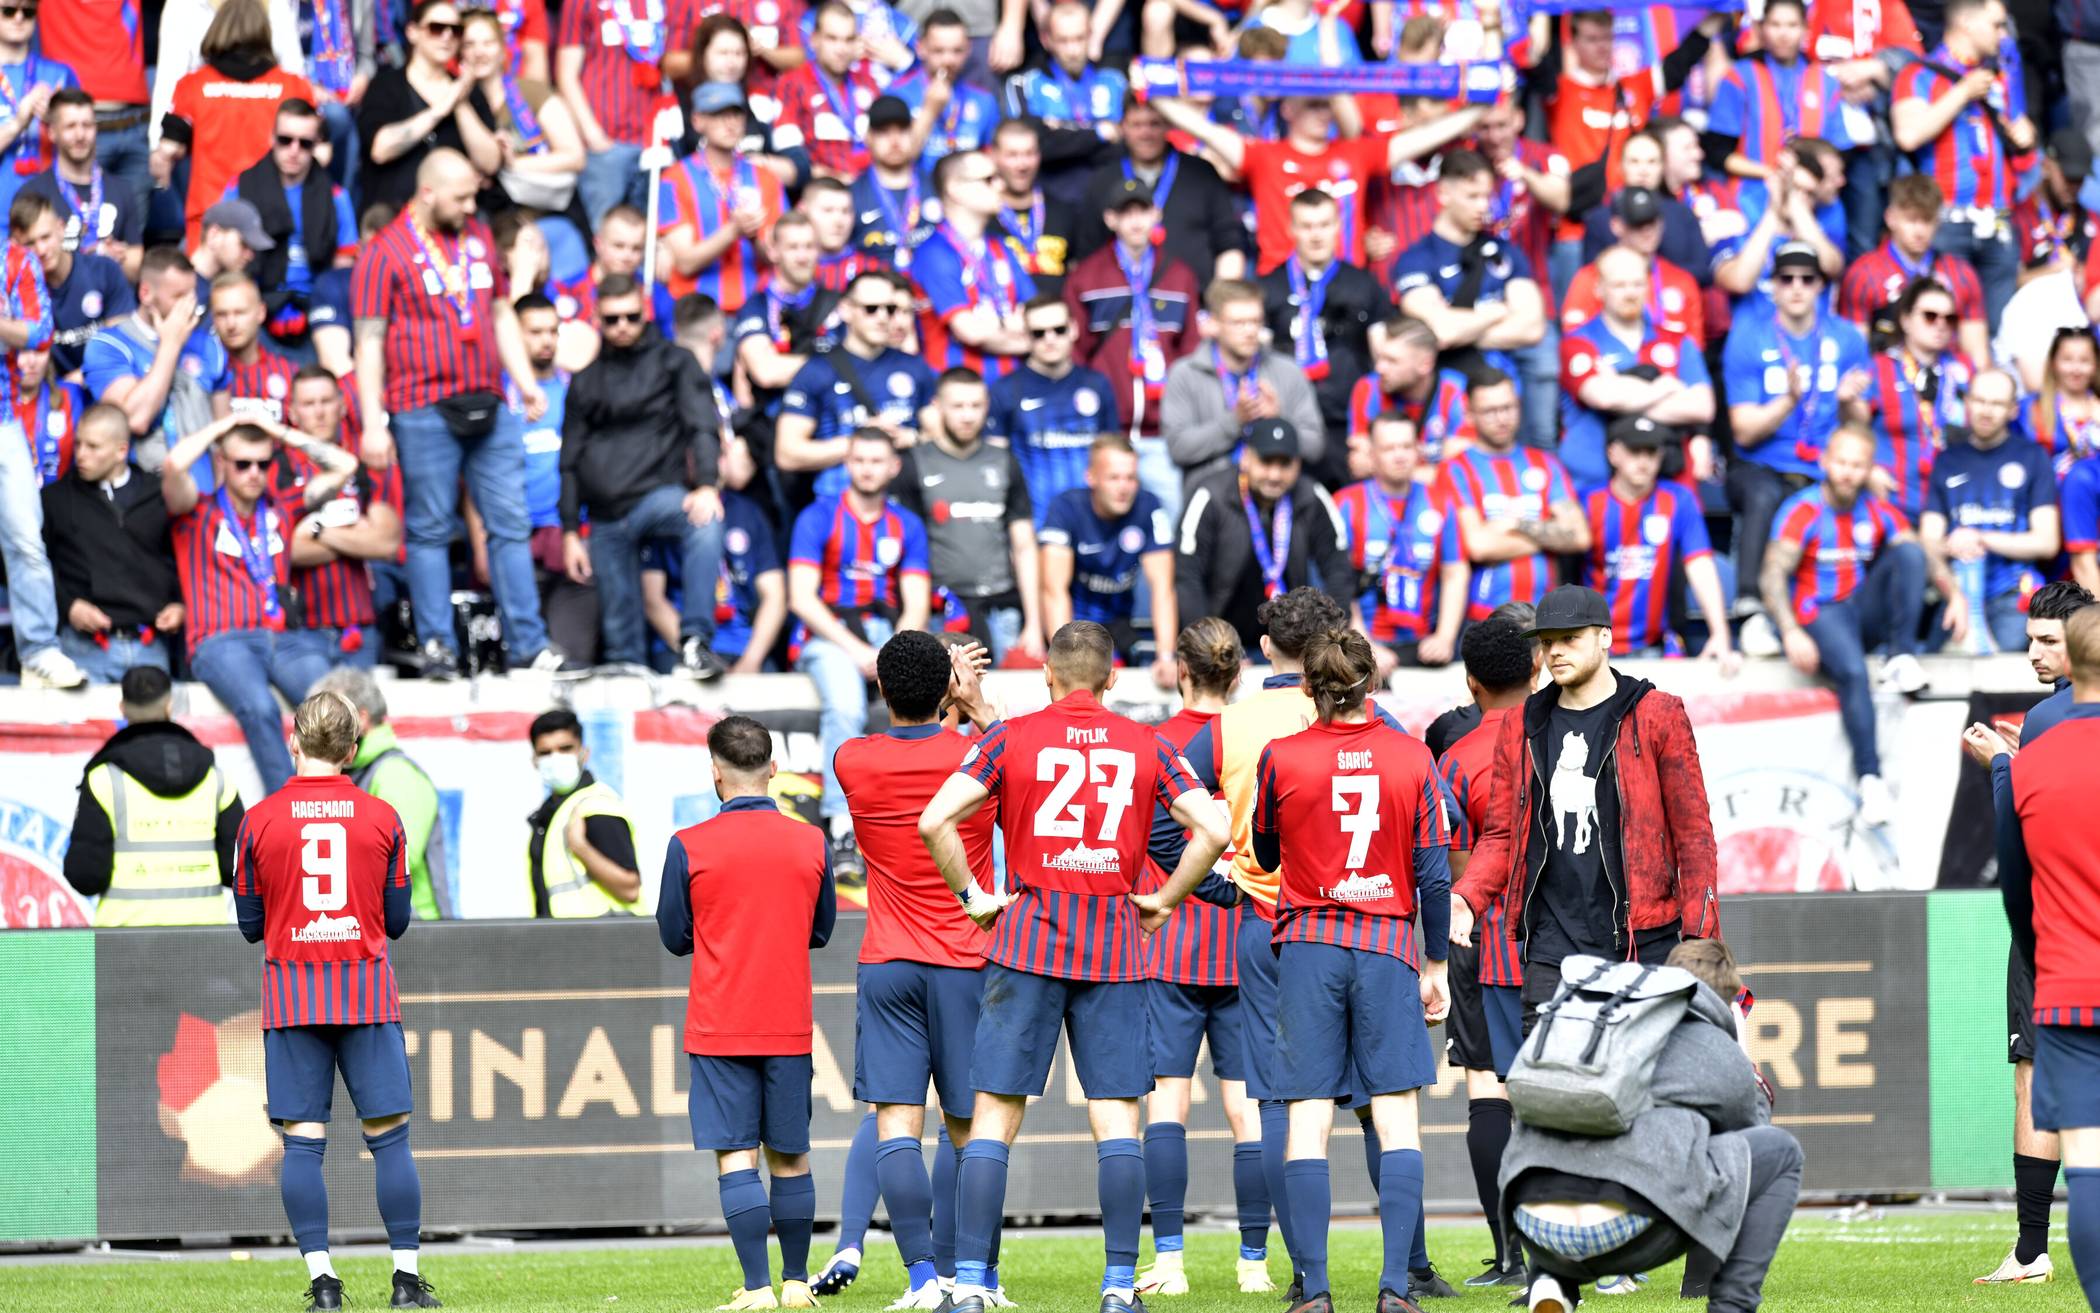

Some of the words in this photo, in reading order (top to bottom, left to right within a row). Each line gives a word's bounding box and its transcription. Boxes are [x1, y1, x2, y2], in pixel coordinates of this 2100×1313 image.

[1066, 727, 1108, 744] PYTLIK
[1337, 749, 1373, 770] ŠARIĆ
[291, 801, 355, 818] HAGEMANN
[1034, 747, 1136, 841] 27
[1332, 775, 1380, 869] 7
[301, 823, 348, 911] 9
